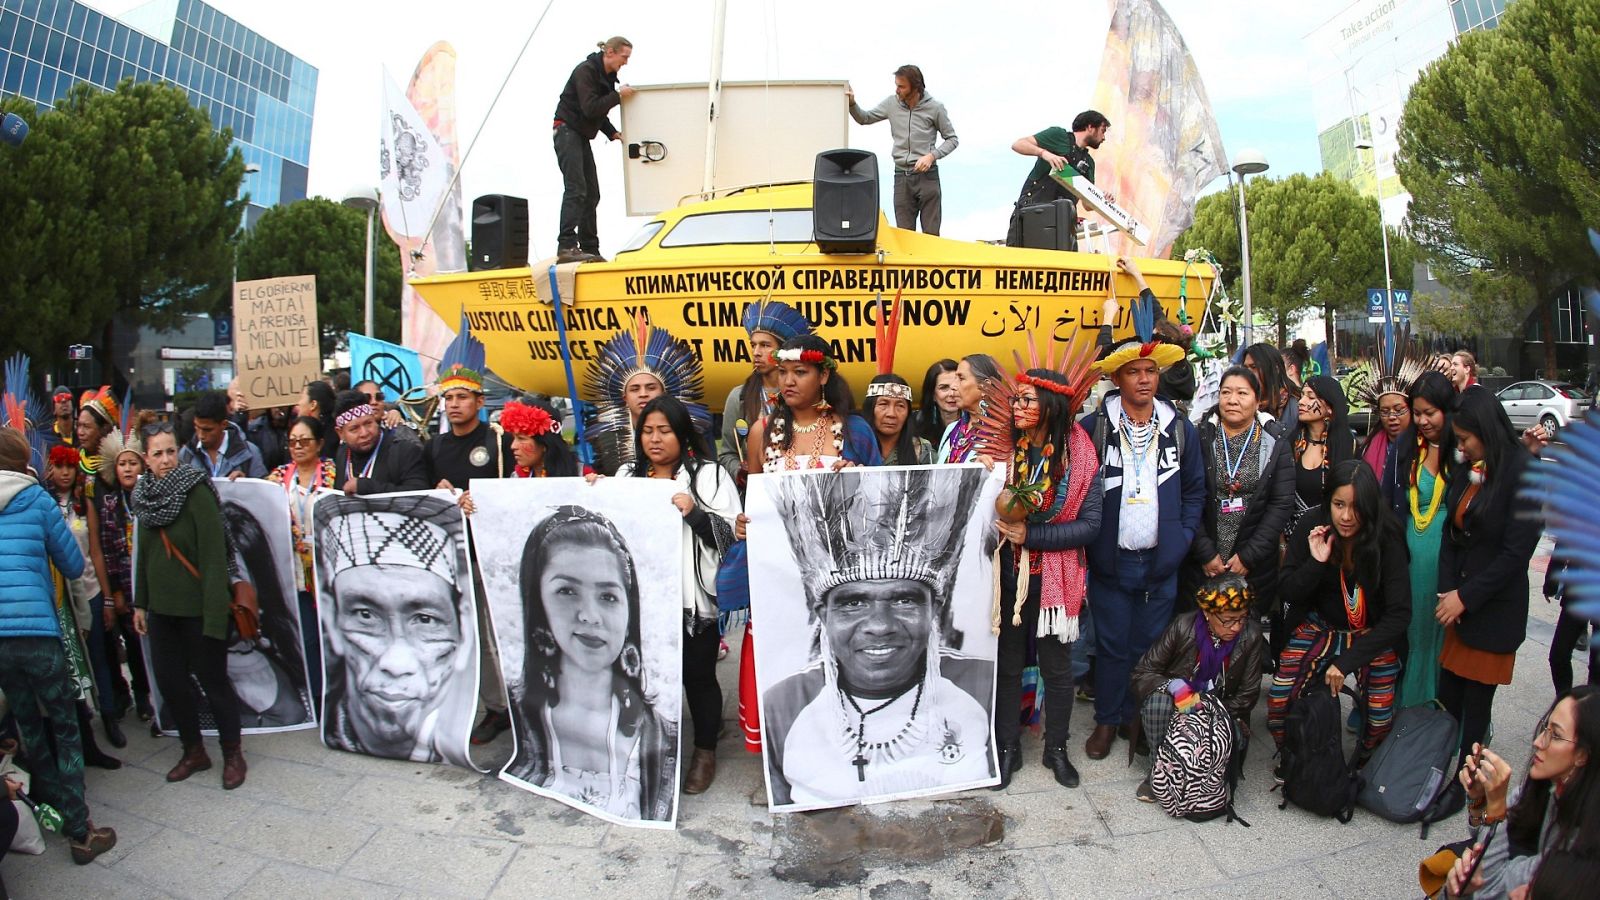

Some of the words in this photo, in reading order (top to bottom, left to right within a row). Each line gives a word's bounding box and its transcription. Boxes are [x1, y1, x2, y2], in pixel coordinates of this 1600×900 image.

[1340, 20, 1363, 40] Take
[239, 288, 254, 301] EL
[1394, 292, 1407, 302] YA
[240, 318, 257, 331] LA
[260, 314, 306, 330] PRENSA
[902, 299, 971, 326] NOW
[528, 340, 592, 361] JUSTCE
[245, 354, 264, 371] LA
[267, 351, 301, 368] ONU
